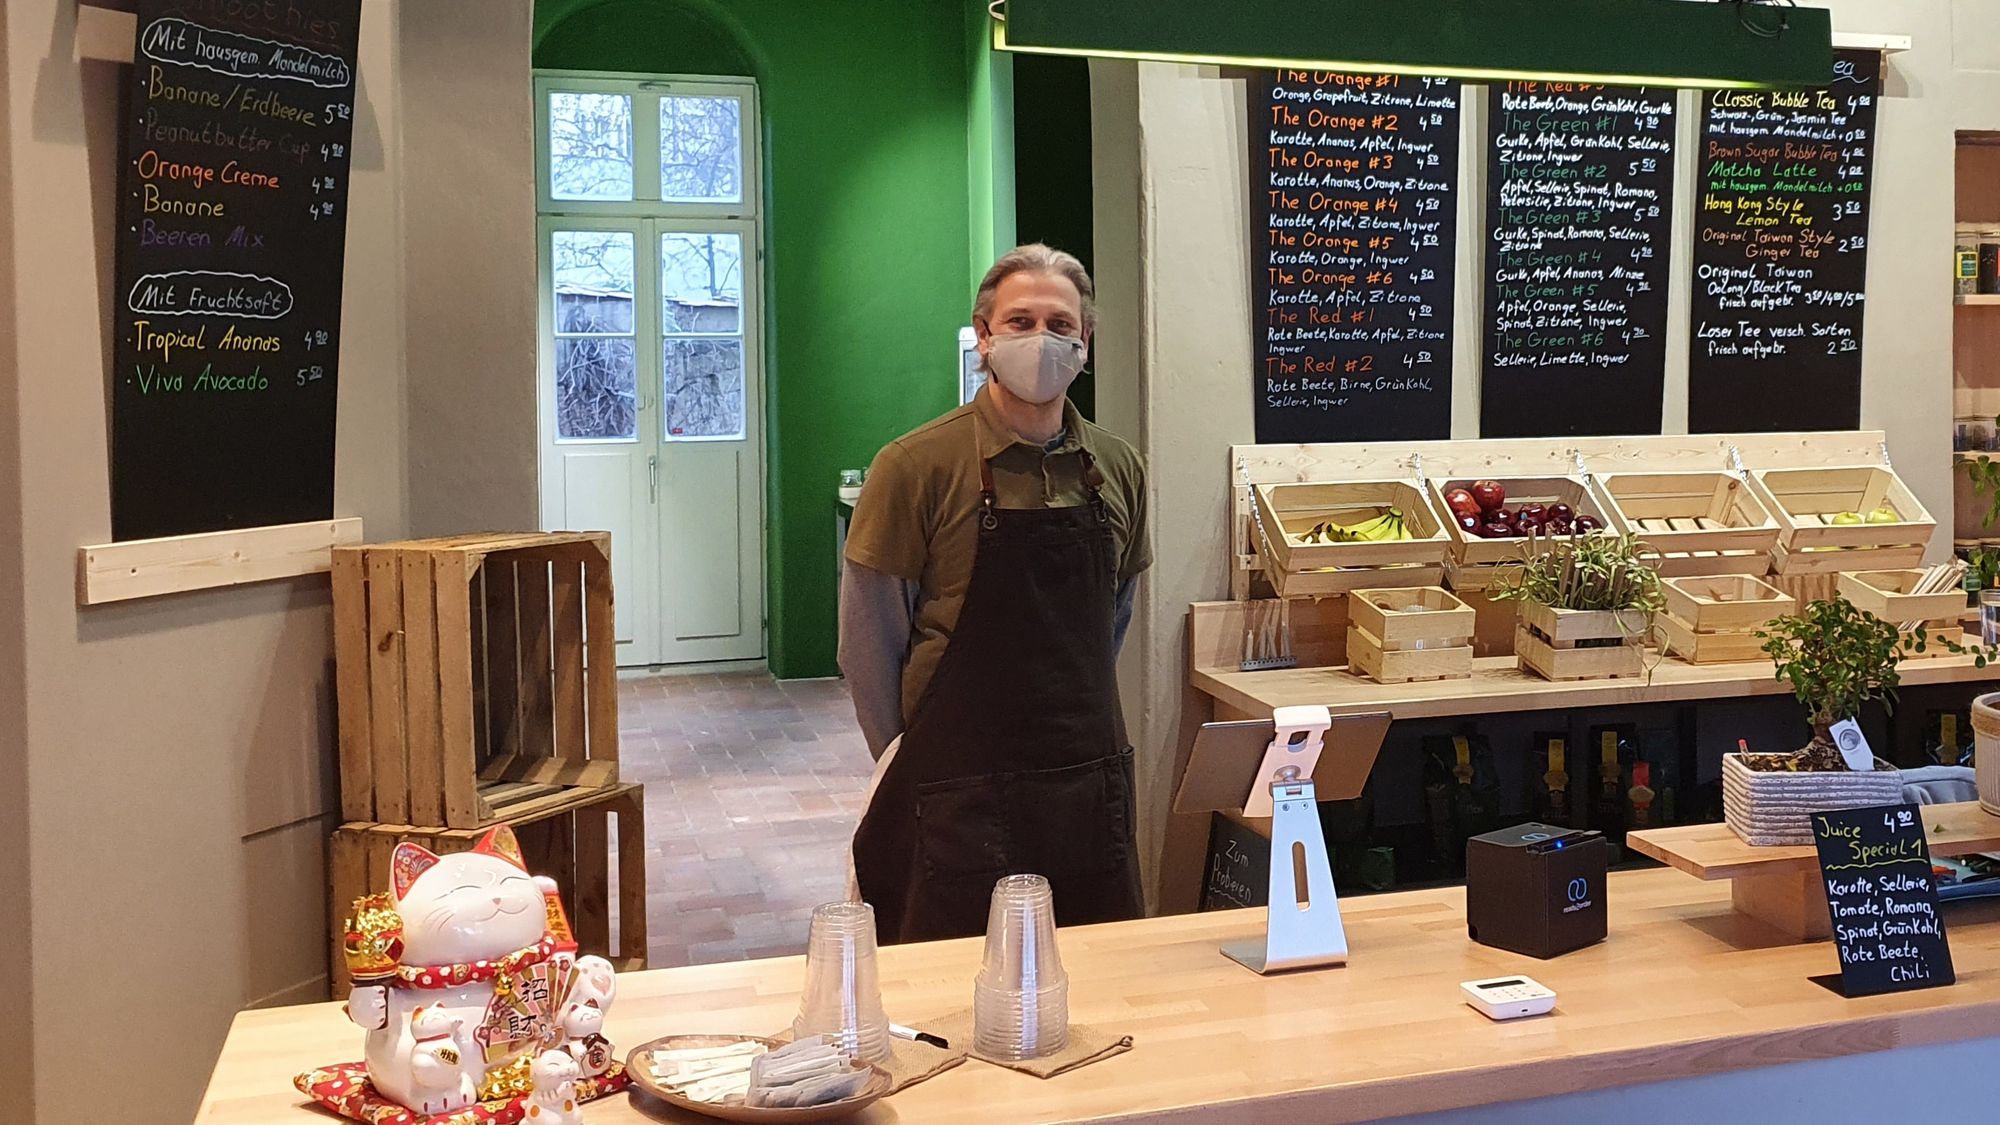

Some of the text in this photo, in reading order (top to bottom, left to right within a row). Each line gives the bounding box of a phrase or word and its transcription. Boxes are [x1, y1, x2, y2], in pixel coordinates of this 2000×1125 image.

[148, 25, 344, 81] Mit hausgem. Mandelmilch
[1833, 61, 1855, 75] ea
[1314, 70, 1372, 90] Orange
[1273, 87, 1311, 103] Orange,
[1416, 94, 1456, 108] Limette
[1503, 93, 1527, 110] Rote
[1712, 90, 1835, 109] Classic Bubble Tea
[1271, 105, 1365, 130] The Orange
[1504, 112, 1589, 133] The Green
[1792, 111, 1846, 125] Jasmin Tee
[1709, 123, 1836, 140] mit Mandelmilch
[1270, 130, 1433, 154] Karotte, Ananas, Apfel, Ingwer
[1535, 132, 1566, 151] Apfel,
[1269, 148, 1359, 173] The Orange
[1548, 150, 1583, 166] Ingwer
[1709, 141, 1837, 163] Brown Sugar Bubble Tea
[139, 150, 279, 188] Orange Creme
[1500, 161, 1577, 179] The Green
[1708, 161, 1817, 177] Matcha Latte
[1270, 172, 1320, 188] Karotte,
[1321, 173, 1361, 191] Ananas,
[1404, 178, 1448, 191] Zitrone
[1574, 182, 1610, 197] Spinat,
[1711, 181, 1832, 192] mit Mandelmilch
[144, 184, 224, 216] Banane
[1268, 191, 1368, 215] The Orange
[1598, 196, 1636, 211] Ingwer
[1705, 193, 1804, 216] Hong Kong Style
[1269, 214, 1440, 234] Karotte, Apfel, Ingwer
[1498, 208, 1569, 225] The Green
[1736, 213, 1812, 226] Lemon Tea
[142, 219, 264, 247] Beeren Mix
[1532, 228, 1566, 241] Spinat,
[1702, 228, 1835, 248] Original Taiwan Style
[1268, 231, 1358, 254] The Orange
[1270, 250, 1409, 270] Karotte, Orange, Ingwer
[1497, 252, 1572, 267] The Green
[1746, 244, 1819, 260] Ginger Tea
[1268, 268, 1356, 291] The Orange
[1609, 266, 1644, 279] Minze
[1698, 264, 1813, 280] Original Taiwan
[1496, 284, 1564, 298] The Green
[1785, 281, 1801, 293] Tea
[137, 285, 281, 313] Mit Fruchtsaft
[1269, 289, 1420, 307] Karotte, Apfel, Zitrone
[1720, 297, 1746, 310] frisch
[1268, 306, 1341, 324] The Red
[1497, 300, 1531, 316] Apfel,
[1533, 300, 1578, 316] Orange,
[1497, 316, 1627, 332] Spinat, Ingwer
[1698, 321, 1851, 338] Loser Tee versch. Sorten
[135, 321, 280, 363] Tropical Ananas
[1268, 328, 1292, 341] Rote
[1329, 329, 1368, 341] Karotte,
[1407, 329, 1444, 340] Zitrone
[1494, 332, 1574, 350] The Green
[1269, 343, 1305, 356] Ingwer
[1708, 341, 1737, 356] frisch
[1266, 356, 1336, 376] The Red
[1591, 353, 1629, 368] Ingwer
[136, 364, 268, 394] Viva Avocado
[1268, 378, 1372, 392] Rote Beete, Birne,
[1313, 396, 1348, 410] Ingwer
[1818, 817, 1861, 837] Juice
[1225, 840, 1248, 867] Zum
[1849, 839, 1921, 864] Special 1
[1212, 853, 1251, 903] Probieren
[1829, 875, 1929, 896] Karotte, Sellerie,
[1830, 897, 1933, 918] Tomate, Romana,
[1837, 922, 1882, 945] Spinat,
[1842, 946, 1875, 963] Rote
